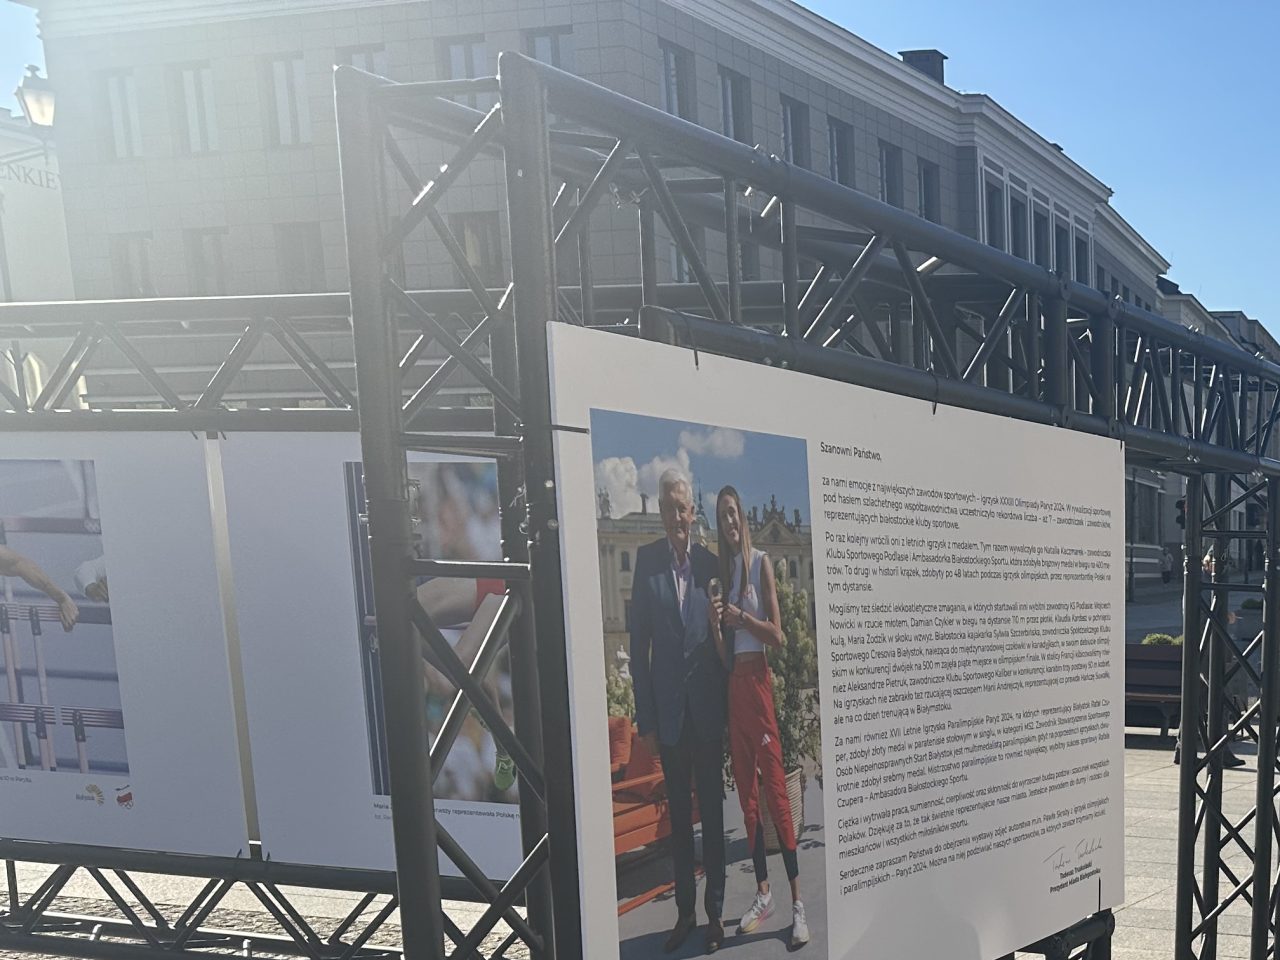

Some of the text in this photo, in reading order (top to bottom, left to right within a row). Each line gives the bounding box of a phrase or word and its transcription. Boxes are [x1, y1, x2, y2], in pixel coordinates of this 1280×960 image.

[820, 442, 852, 456] Szanowni
[822, 477, 830, 486] za
[831, 478, 848, 488] nami
[823, 493, 837, 505] pod
[838, 494, 862, 505] hasłem
[825, 532, 834, 542] Po
[836, 535, 846, 543] raz
[847, 533, 869, 546] kolejny
[826, 548, 846, 559] Klubu
[846, 549, 883, 562] Sportowego
[845, 565, 852, 575] To
[827, 581, 842, 593] tym
[829, 619, 856, 629] Nowicki
[847, 635, 865, 645] Maria
[831, 651, 870, 663] Sportowego
[832, 667, 848, 677] skim
[833, 699, 843, 709] Na
[844, 695, 877, 709] igrzyskach
[834, 715, 844, 725] ale
[845, 715, 854, 723] na
[854, 714, 862, 722] co
[834, 736, 843, 746] Za
[845, 733, 862, 744] nami
[849, 747, 870, 759] zdobył
[836, 780, 860, 792] krotnie
[837, 795, 863, 808] Czupera
[840, 862, 874, 880] Serdecznie
